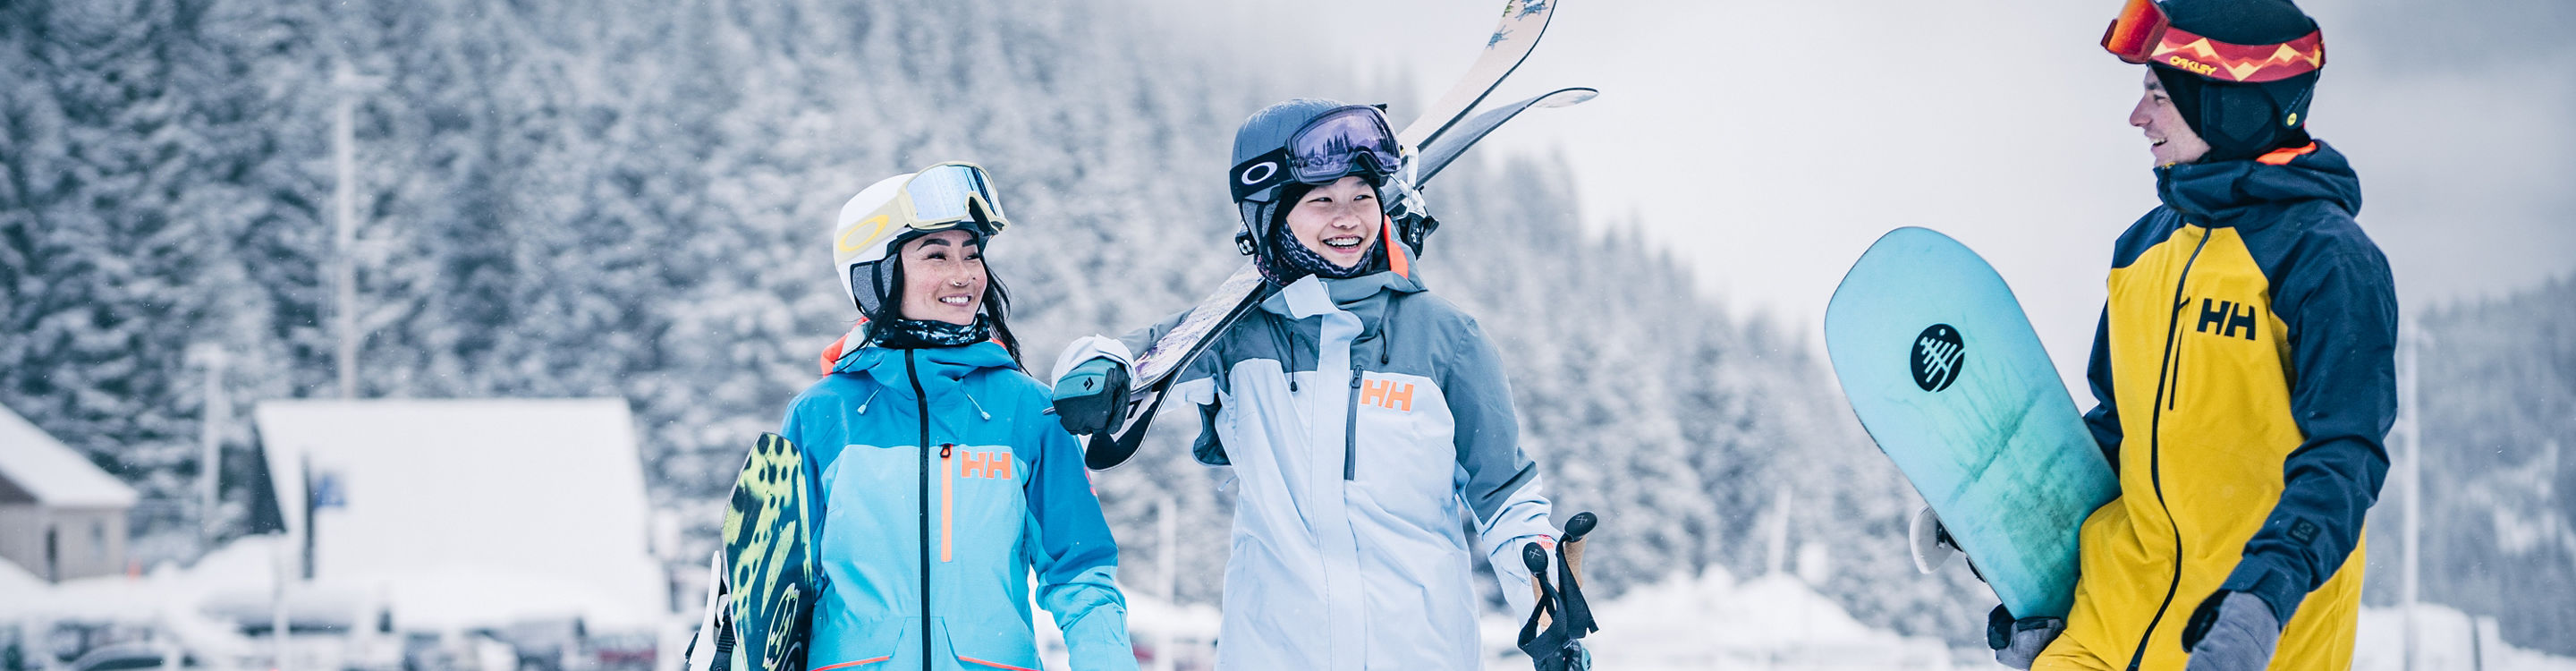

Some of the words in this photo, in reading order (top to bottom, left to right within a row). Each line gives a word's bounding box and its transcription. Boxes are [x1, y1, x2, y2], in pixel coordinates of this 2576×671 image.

[2169, 55, 2217, 76] OAKLEY
[2197, 298, 2256, 341] HH
[1361, 379, 1414, 412] HH
[962, 451, 1012, 480] HH
